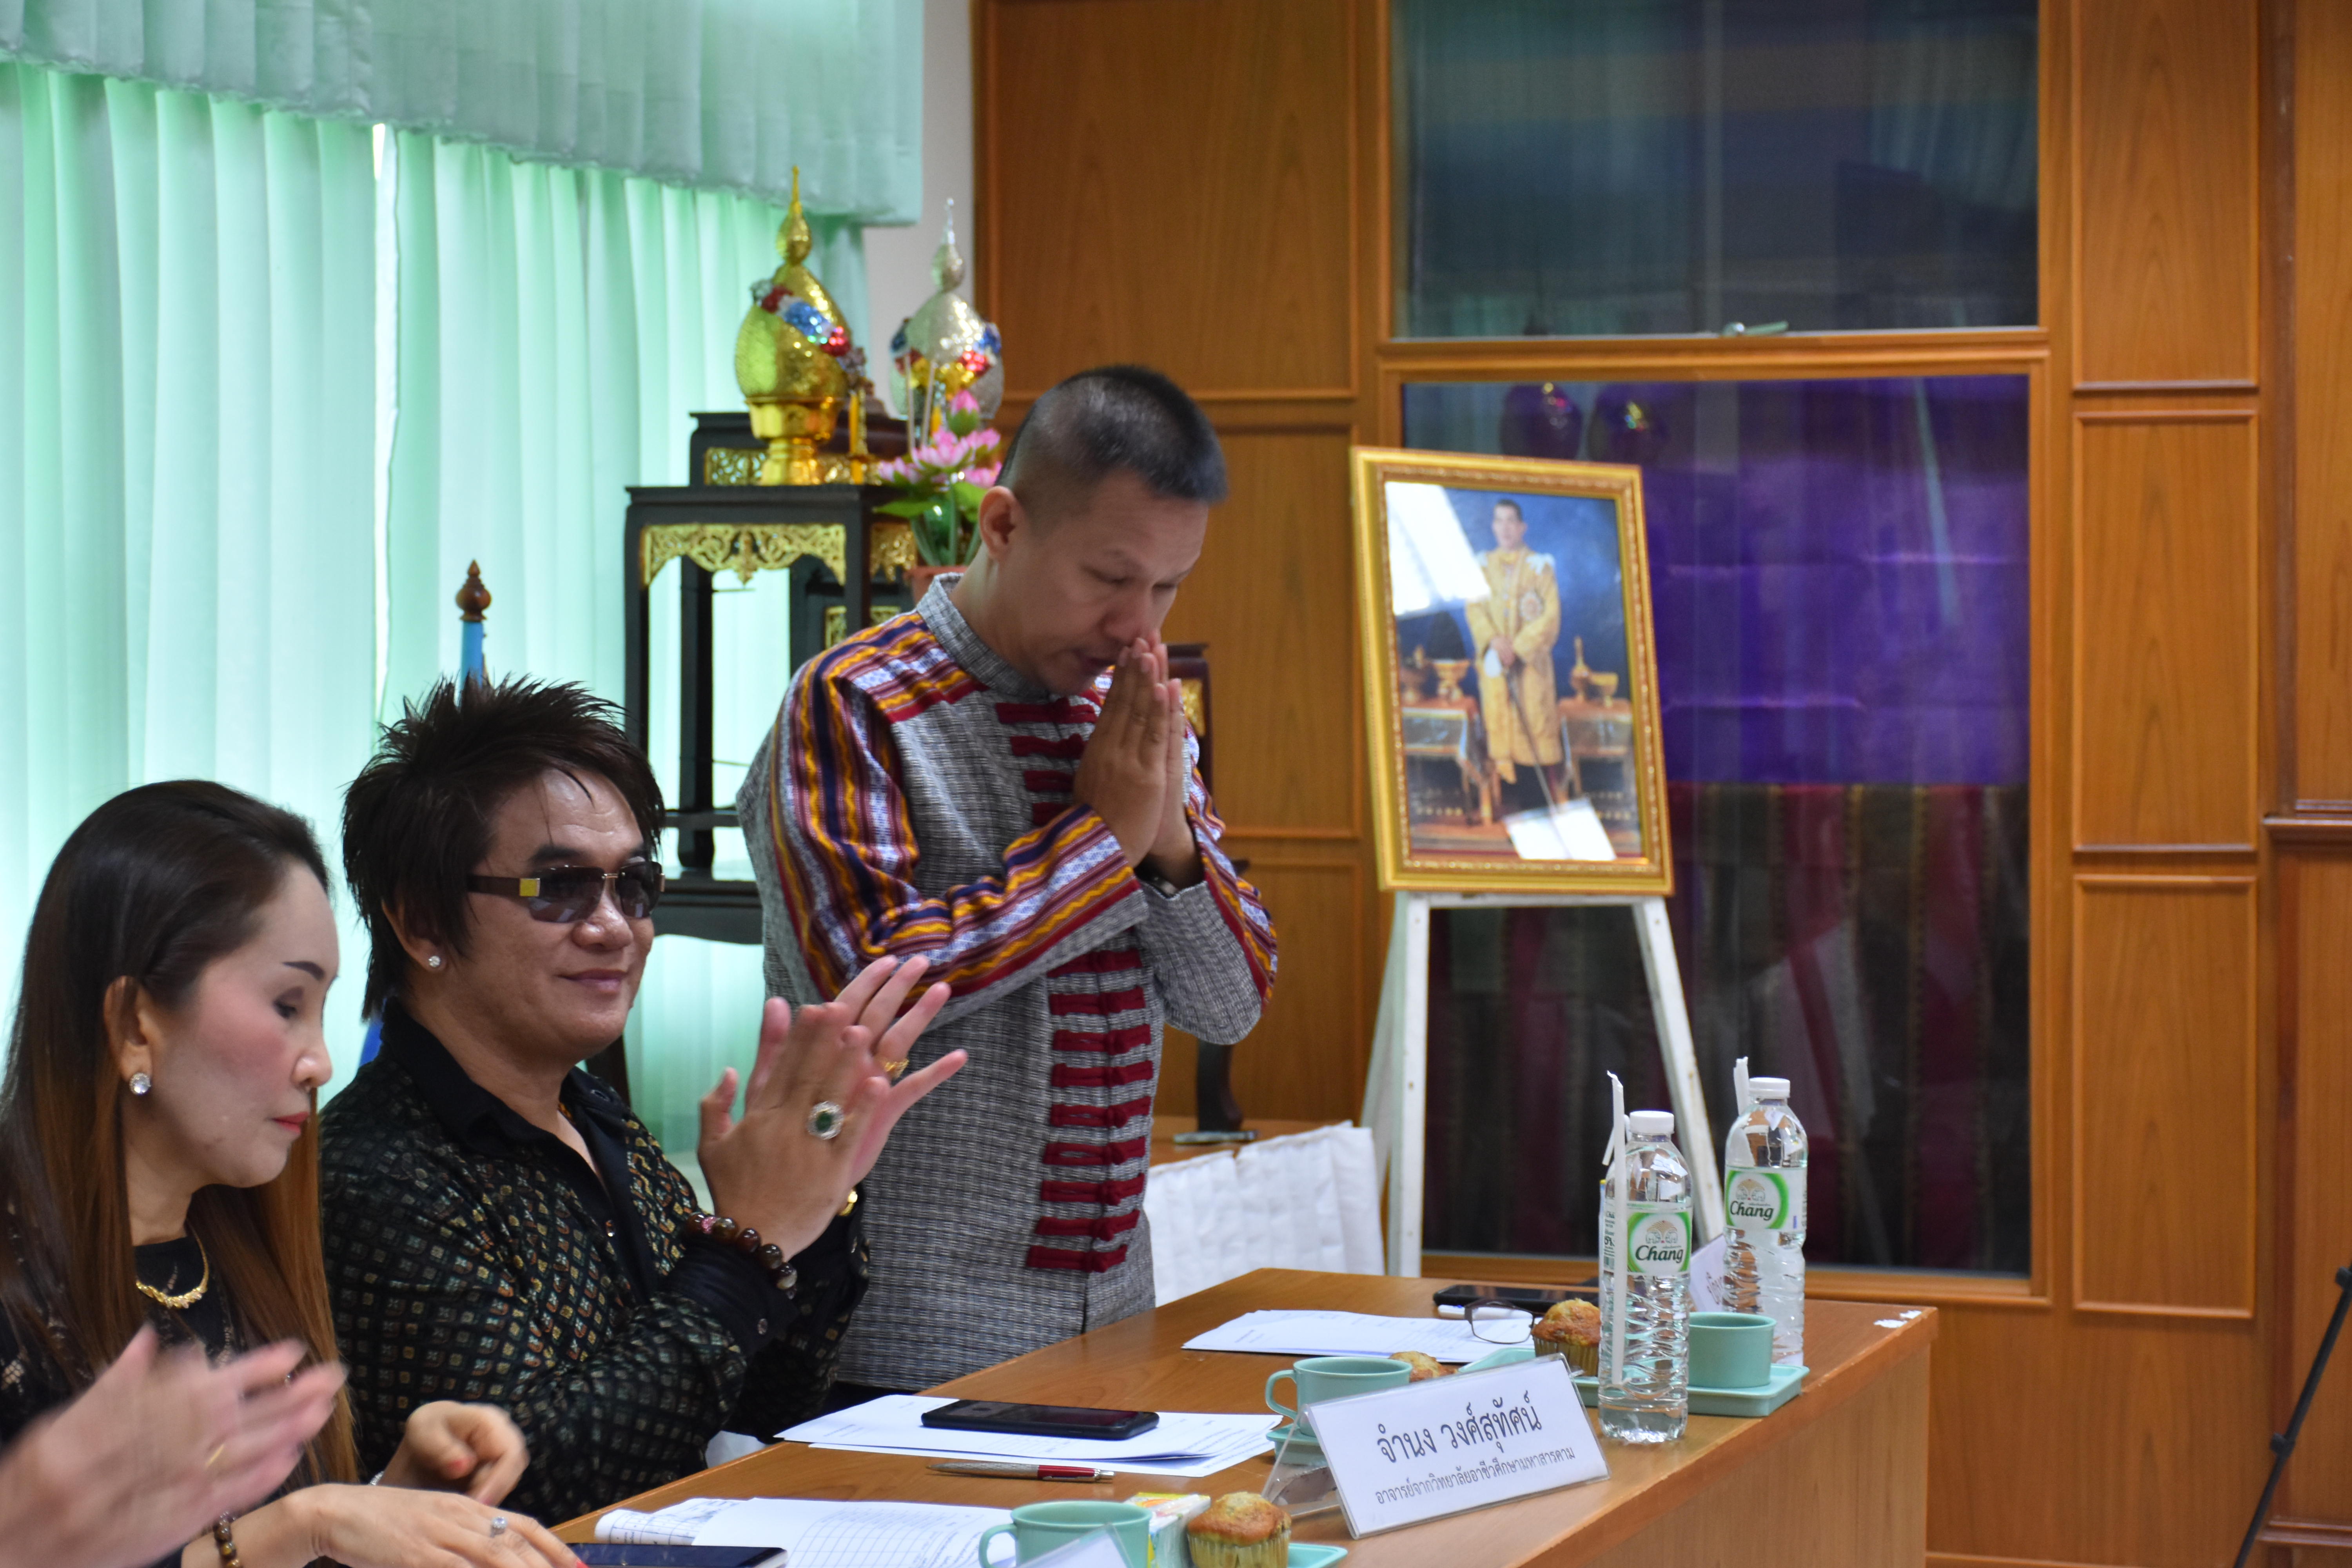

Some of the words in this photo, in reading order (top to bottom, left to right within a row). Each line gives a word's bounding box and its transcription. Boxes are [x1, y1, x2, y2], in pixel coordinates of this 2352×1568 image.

[1730, 1200, 1774, 1221] Chang
[1635, 1245, 1684, 1263] Chang
[1377, 1423, 1437, 1463] จำนง
[1440, 1390, 1542, 1453] วงศ์สุทัศน์
[1375, 1447, 1576, 1504] อาจารย์จากวิทยาลัยอาชีวศึกษามหาสารคาม
